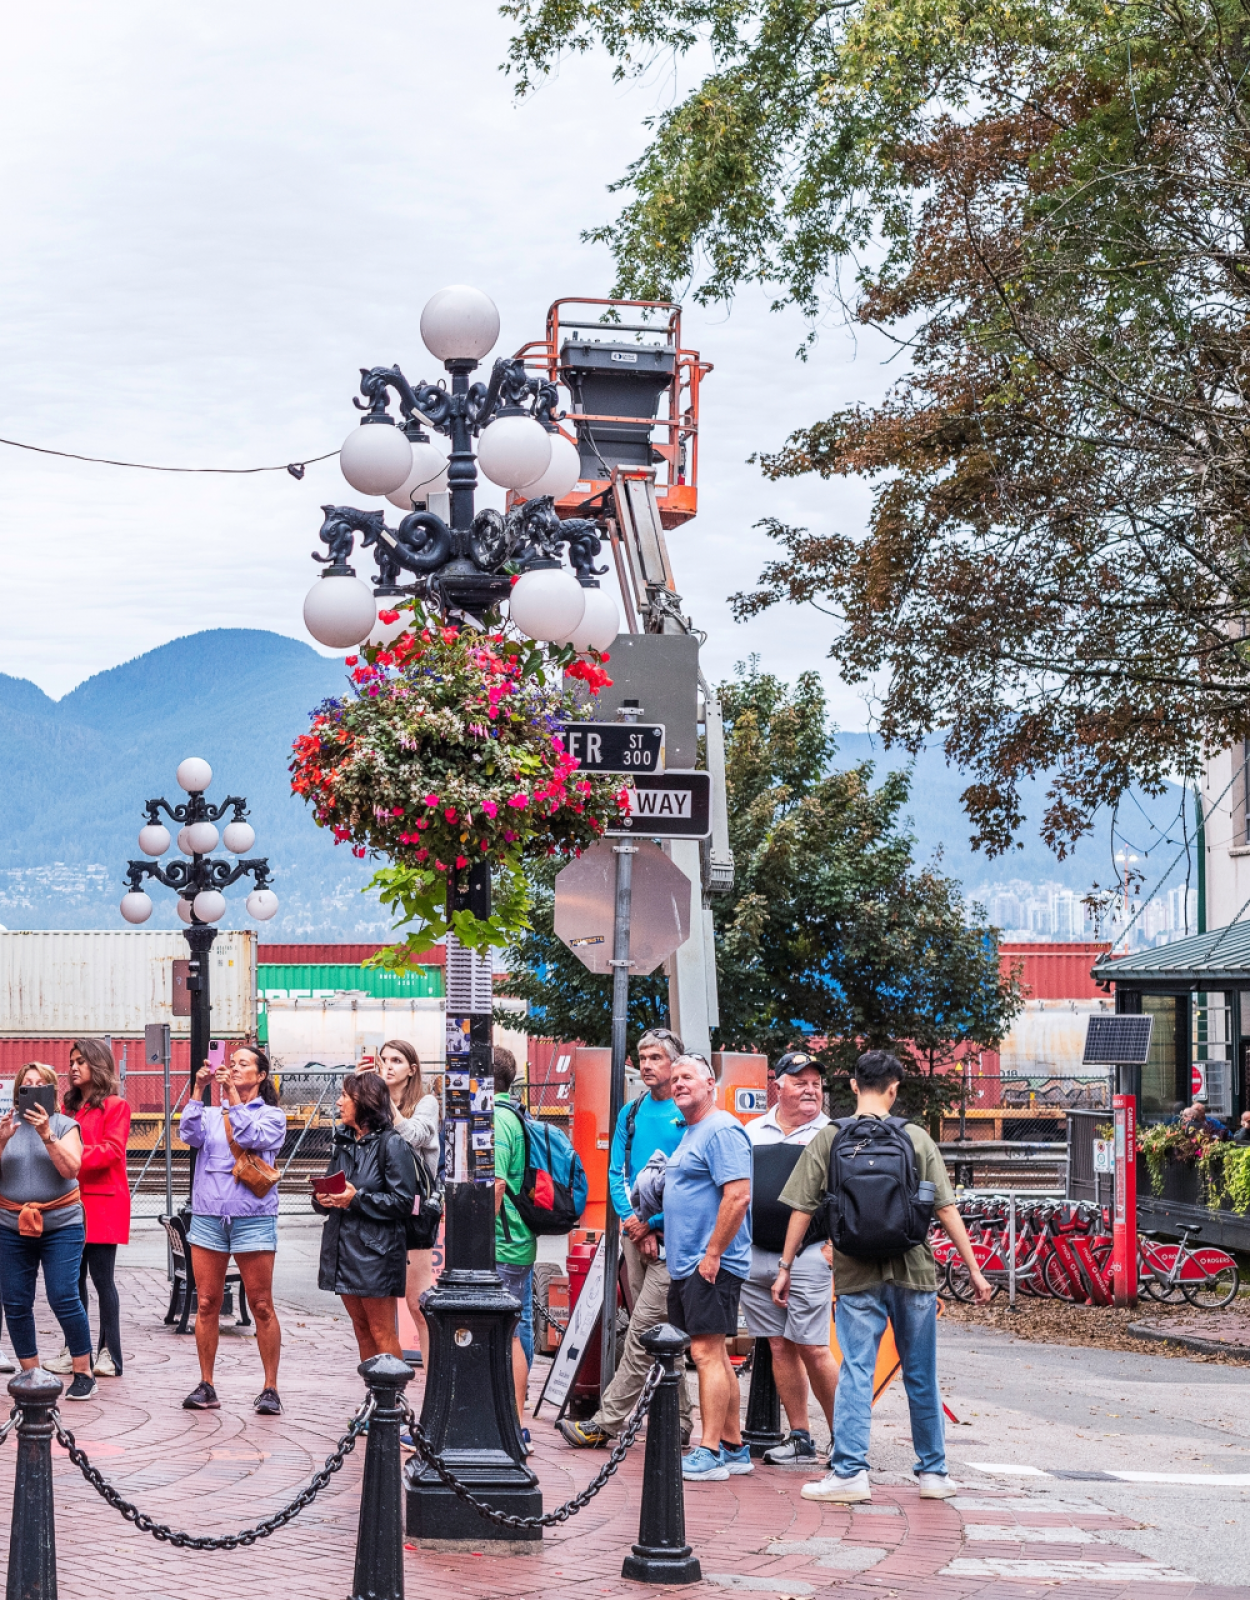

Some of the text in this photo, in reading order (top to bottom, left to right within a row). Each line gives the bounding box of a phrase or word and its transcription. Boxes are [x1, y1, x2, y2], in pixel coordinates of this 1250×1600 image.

[630, 734, 644, 749] ST
[623, 751, 650, 766] 300
[637, 793, 688, 814] WAY
[1094, 1273, 1109, 1296] ROGERS
